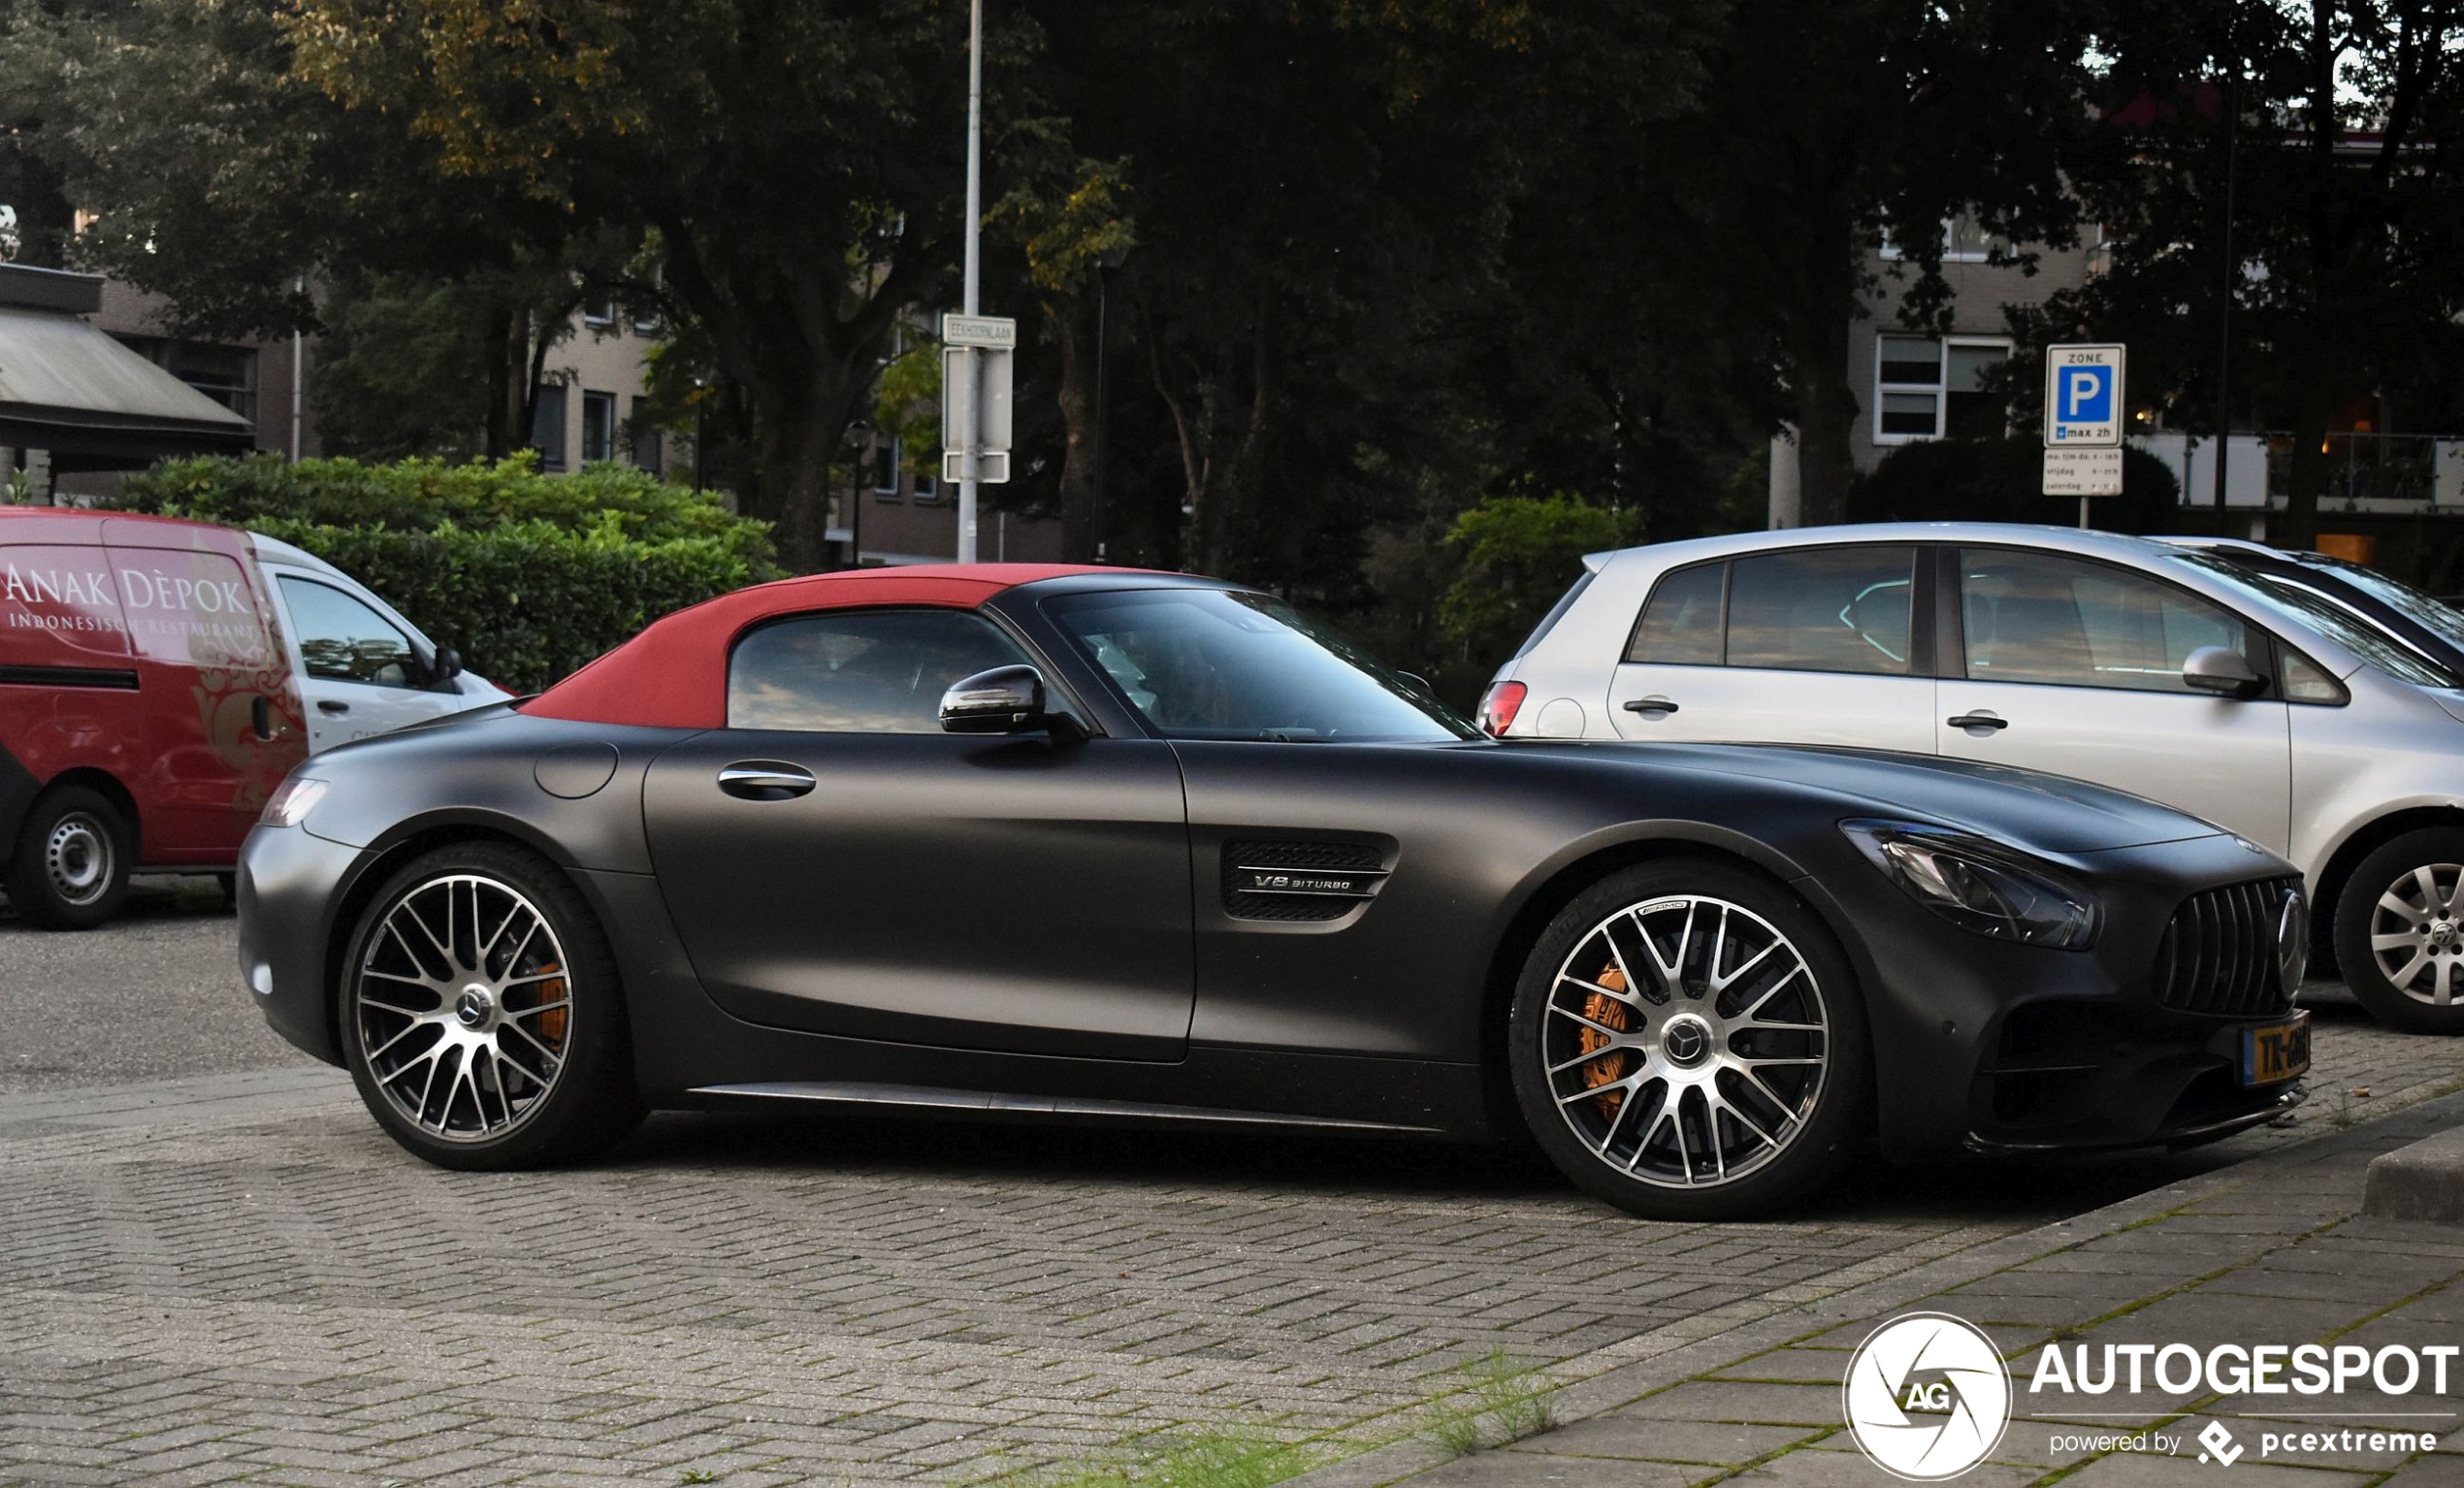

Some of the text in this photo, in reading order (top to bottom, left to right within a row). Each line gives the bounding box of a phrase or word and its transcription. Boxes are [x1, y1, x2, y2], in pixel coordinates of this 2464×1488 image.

[2068, 353, 2103, 364] ZONE
[2069, 372, 2100, 416] P
[2067, 428, 2111, 437] max 2h
[6, 563, 250, 614] ANAK DÈPOK
[10, 613, 255, 640] INDONESISCH RESTAURANT
[1255, 876, 1350, 890] V8 BITURBO
